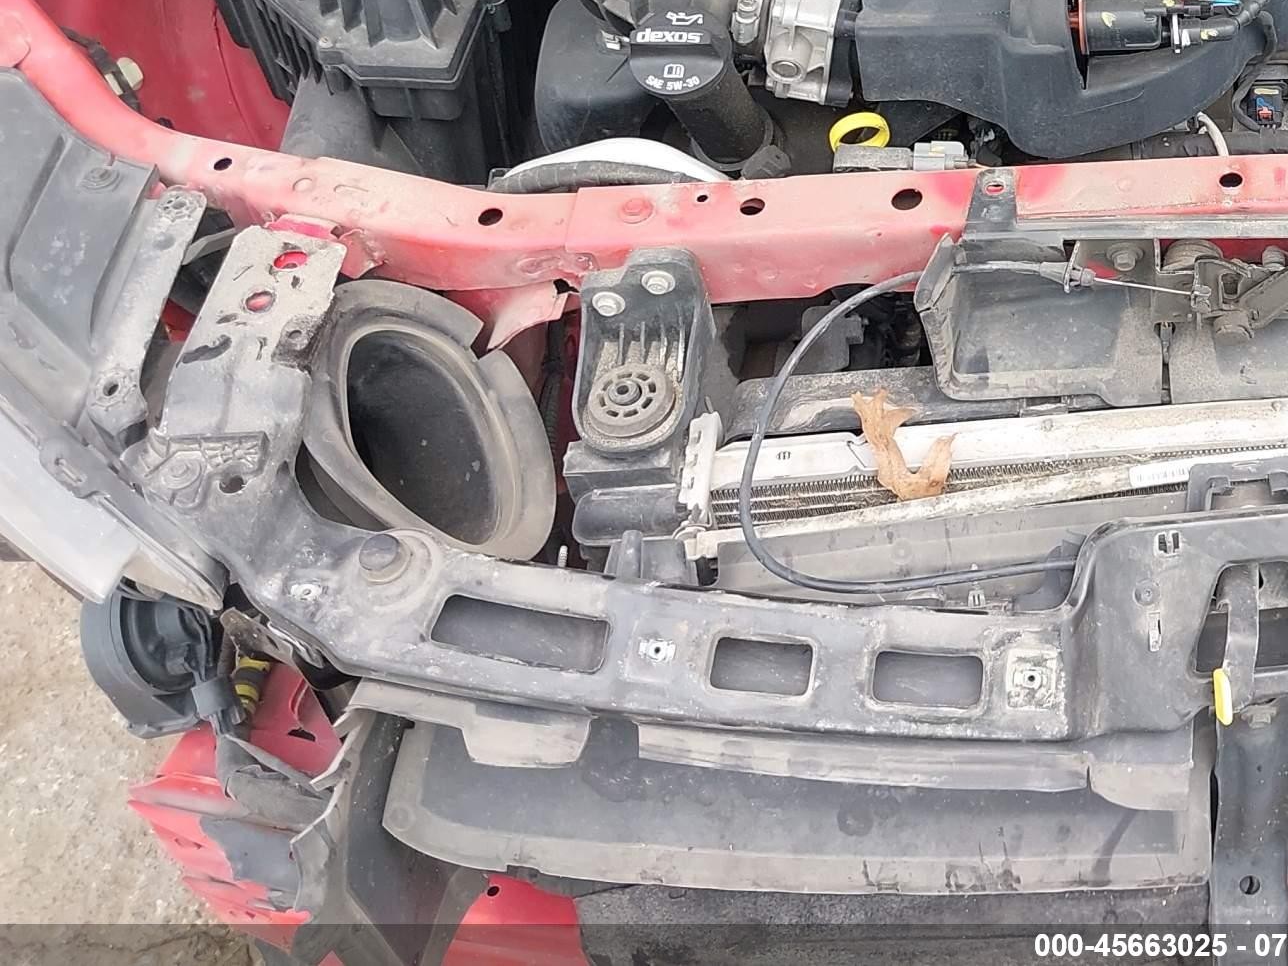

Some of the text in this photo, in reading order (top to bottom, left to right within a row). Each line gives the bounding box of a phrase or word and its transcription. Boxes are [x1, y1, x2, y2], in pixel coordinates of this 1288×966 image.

[636, 28, 703, 43] dexos
[645, 75, 700, 91] SAE 5W-30
